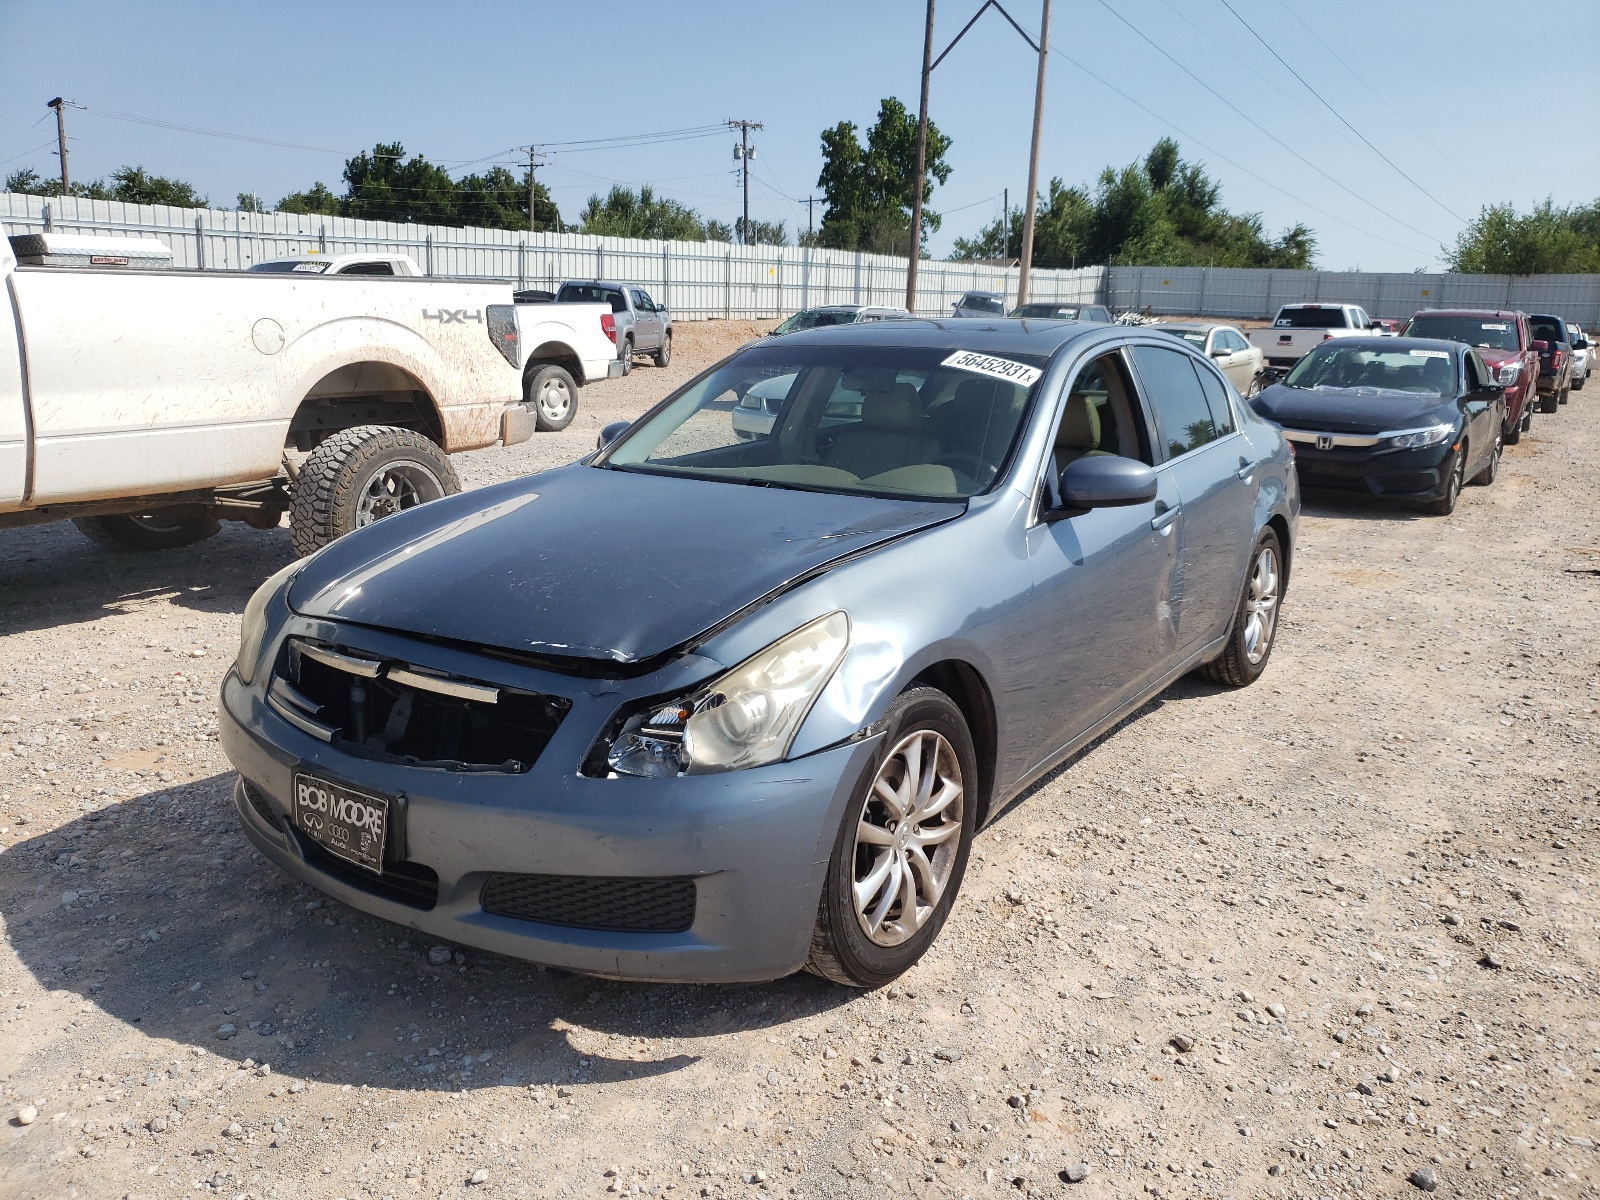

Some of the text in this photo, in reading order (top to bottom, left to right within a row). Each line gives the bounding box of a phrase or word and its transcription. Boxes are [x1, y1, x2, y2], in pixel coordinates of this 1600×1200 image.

[956, 353, 1032, 379] 56452931
[298, 783, 383, 843] BOB MOORE
